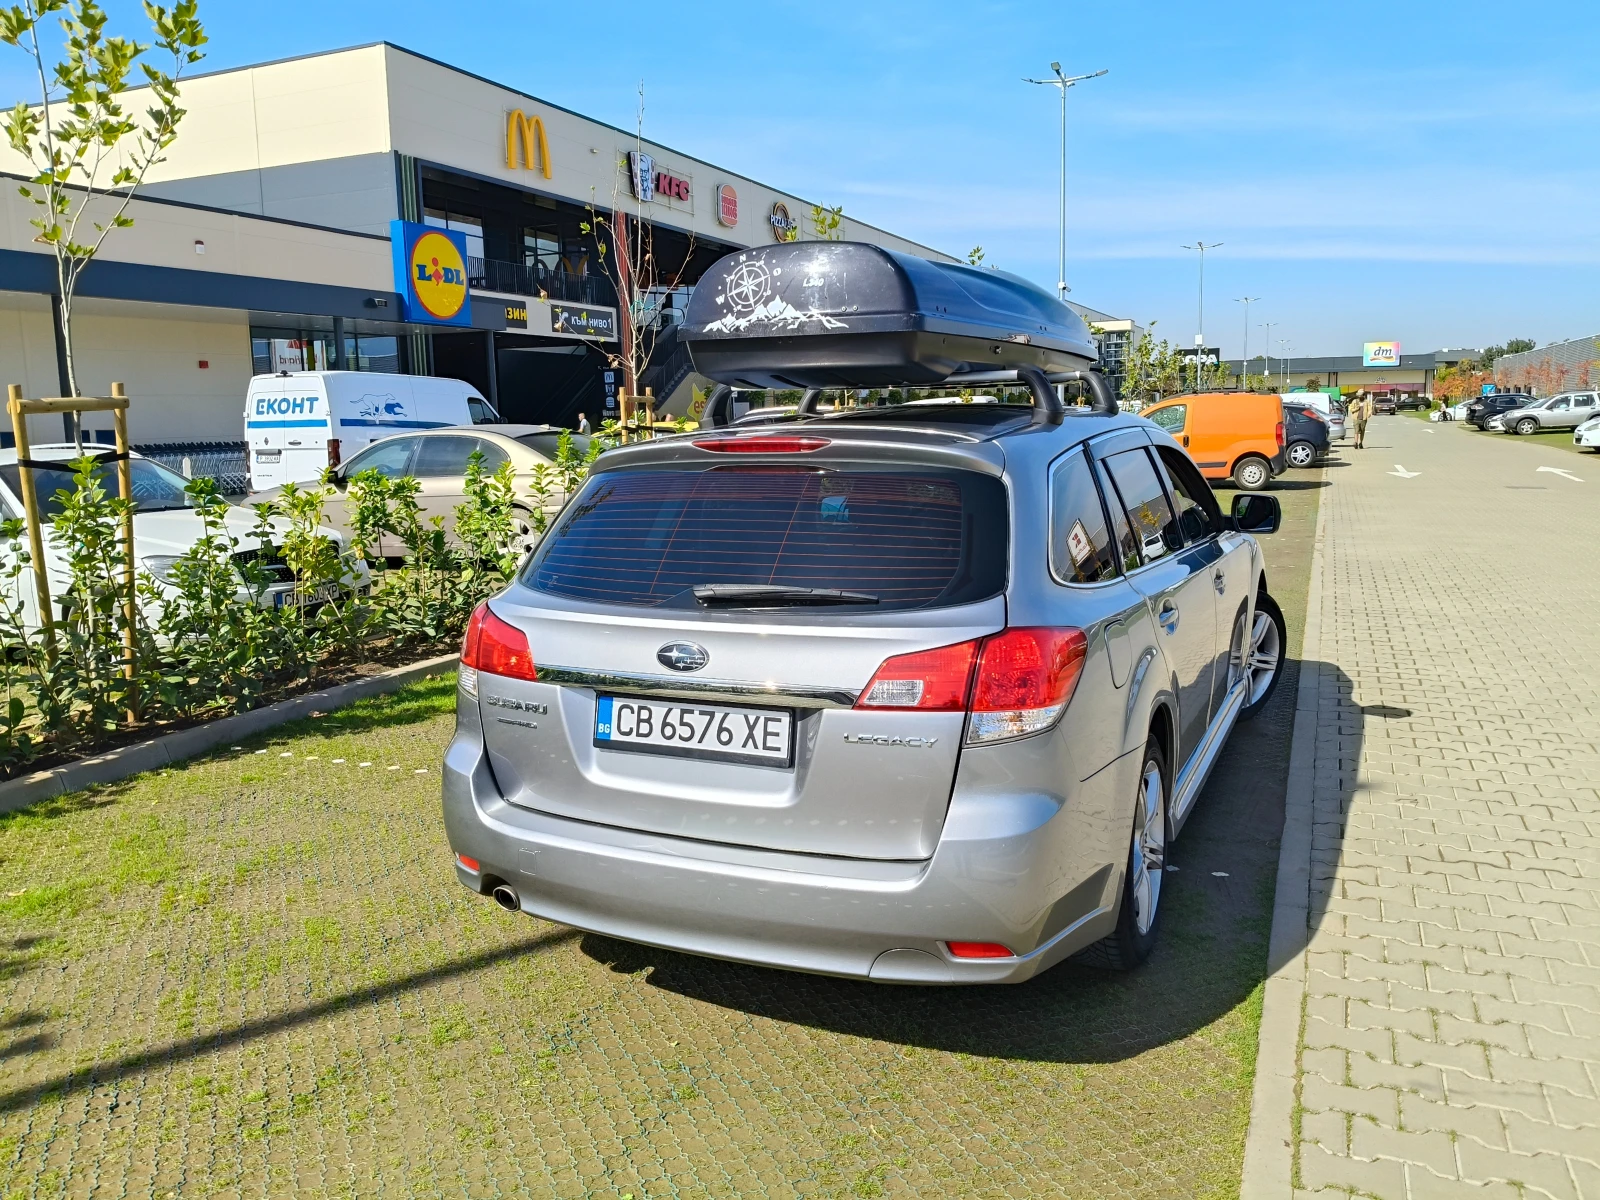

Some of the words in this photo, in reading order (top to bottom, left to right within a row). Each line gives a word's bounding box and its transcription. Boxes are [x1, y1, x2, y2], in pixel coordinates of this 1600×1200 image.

[657, 172, 689, 201] KFC
[505, 307, 528, 321] ЗИН
[1373, 346, 1393, 357] dm
[255, 396, 320, 416] ЕКОНТ
[486, 694, 548, 716] SUBARU
[598, 723, 611, 734] BG
[616, 704, 654, 738] CB
[660, 707, 734, 747] 6576
[741, 713, 783, 753] XE
[843, 732, 939, 749] LEGACY
